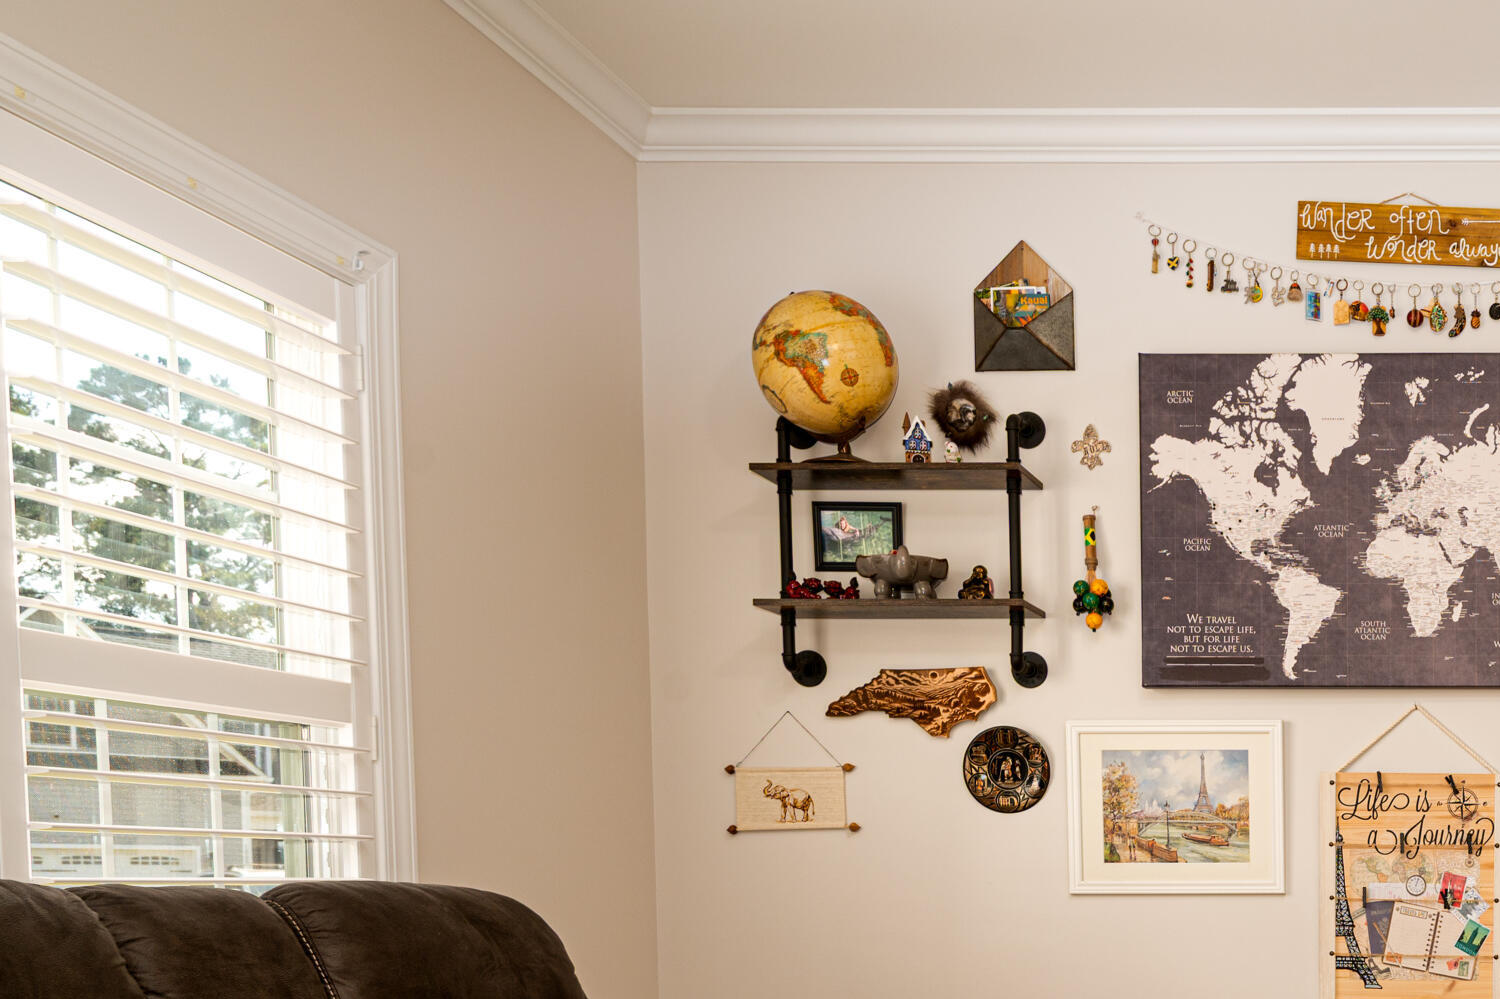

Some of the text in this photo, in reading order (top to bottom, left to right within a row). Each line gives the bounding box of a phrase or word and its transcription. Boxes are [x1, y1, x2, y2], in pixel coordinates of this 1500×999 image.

[1389, 206, 1450, 240] often
[1167, 625, 1257, 635] NOT TO ESCAPE LIFE,
[1183, 635, 1240, 643] BUT FOR LIFE
[1170, 644, 1254, 653] NOT TO ESCAPE US.
[1338, 778, 1432, 820] Life is
[1404, 814, 1495, 860] Journey
